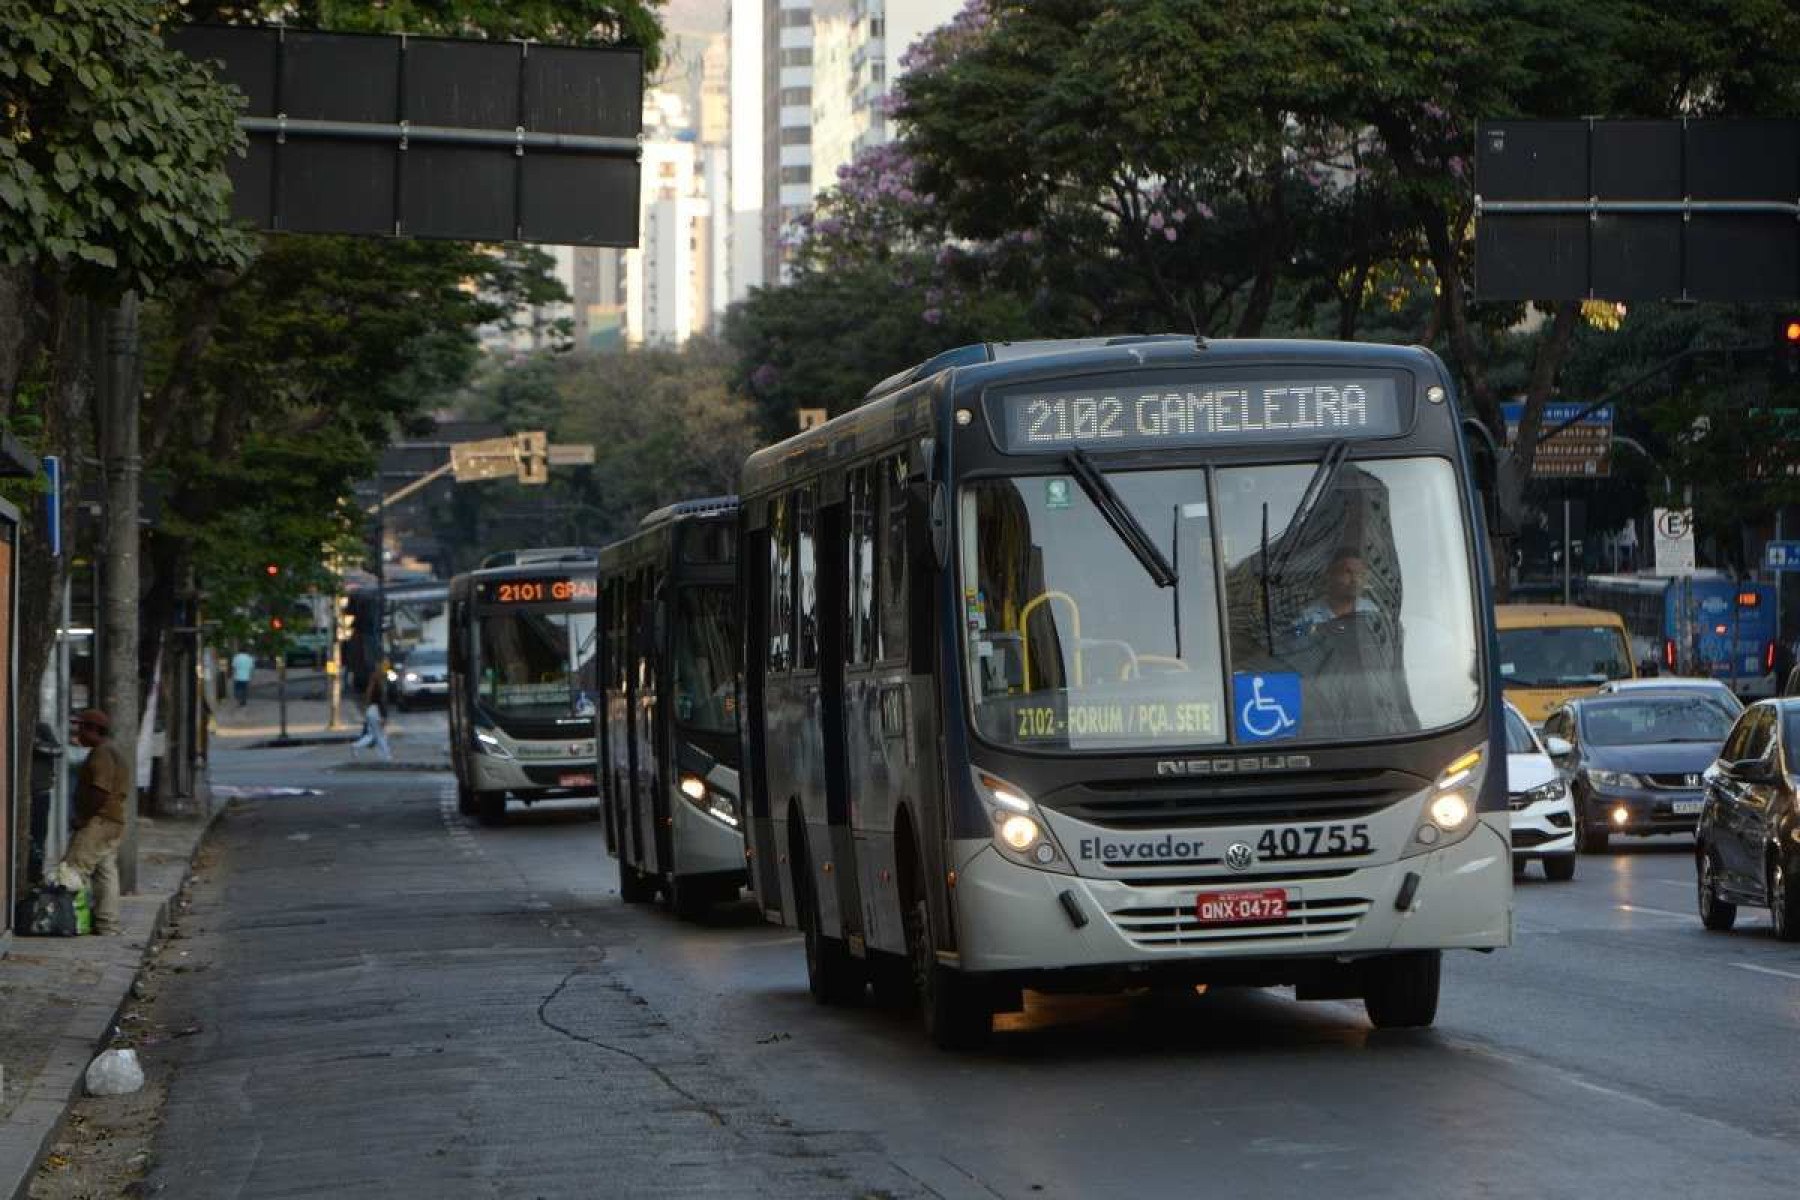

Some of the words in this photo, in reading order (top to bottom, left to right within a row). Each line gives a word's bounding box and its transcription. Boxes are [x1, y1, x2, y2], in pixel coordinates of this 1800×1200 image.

[1028, 396, 1124, 441] 2102
[1135, 385, 1367, 434] GAMELEIRA
[499, 583, 543, 601] 2101
[551, 581, 598, 600] GRA
[1017, 707, 1055, 736] 2102
[1176, 702, 1211, 732] SETE
[1080, 834, 1204, 859] Elevador
[1257, 824, 1370, 857] 40755
